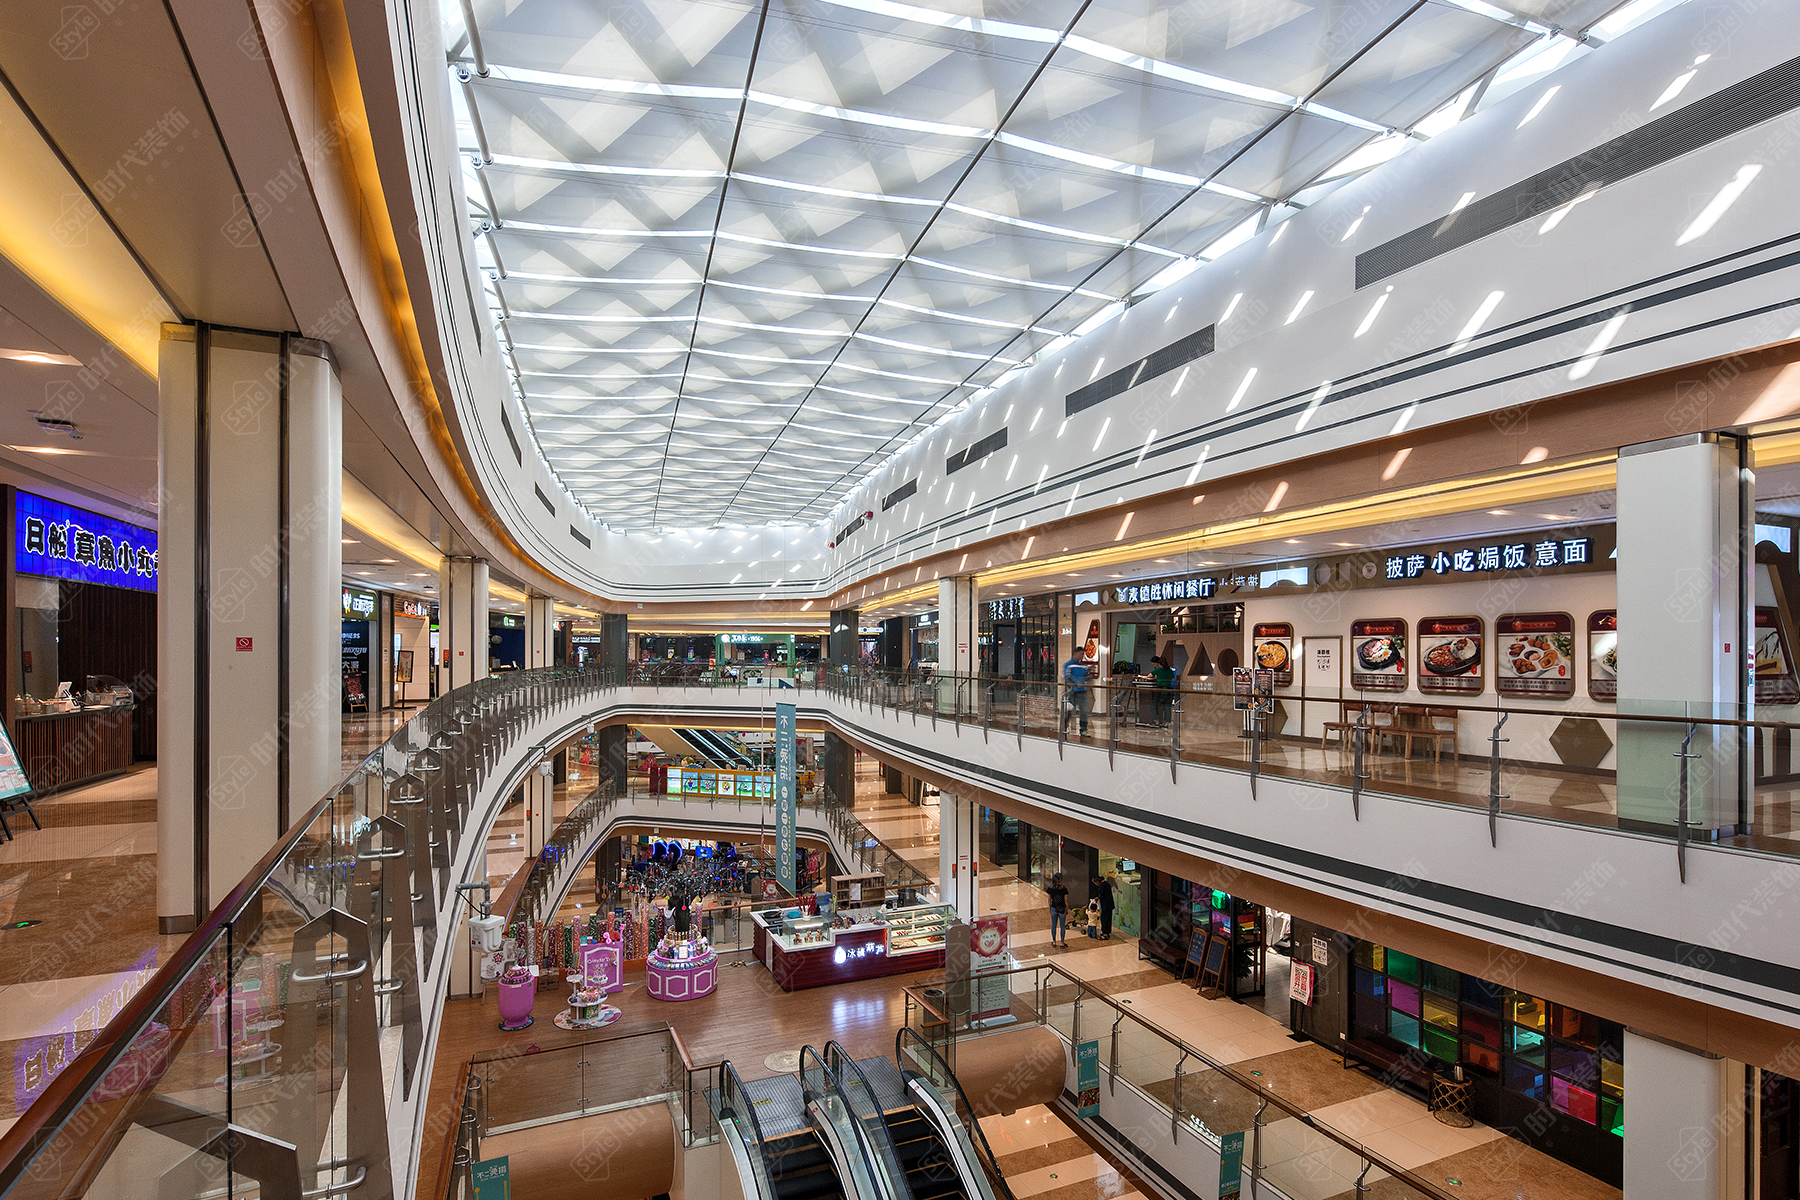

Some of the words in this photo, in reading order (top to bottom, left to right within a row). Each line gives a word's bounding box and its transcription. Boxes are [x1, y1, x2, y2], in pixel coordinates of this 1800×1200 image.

[25, 516, 158, 578] 日船章魚小丸
